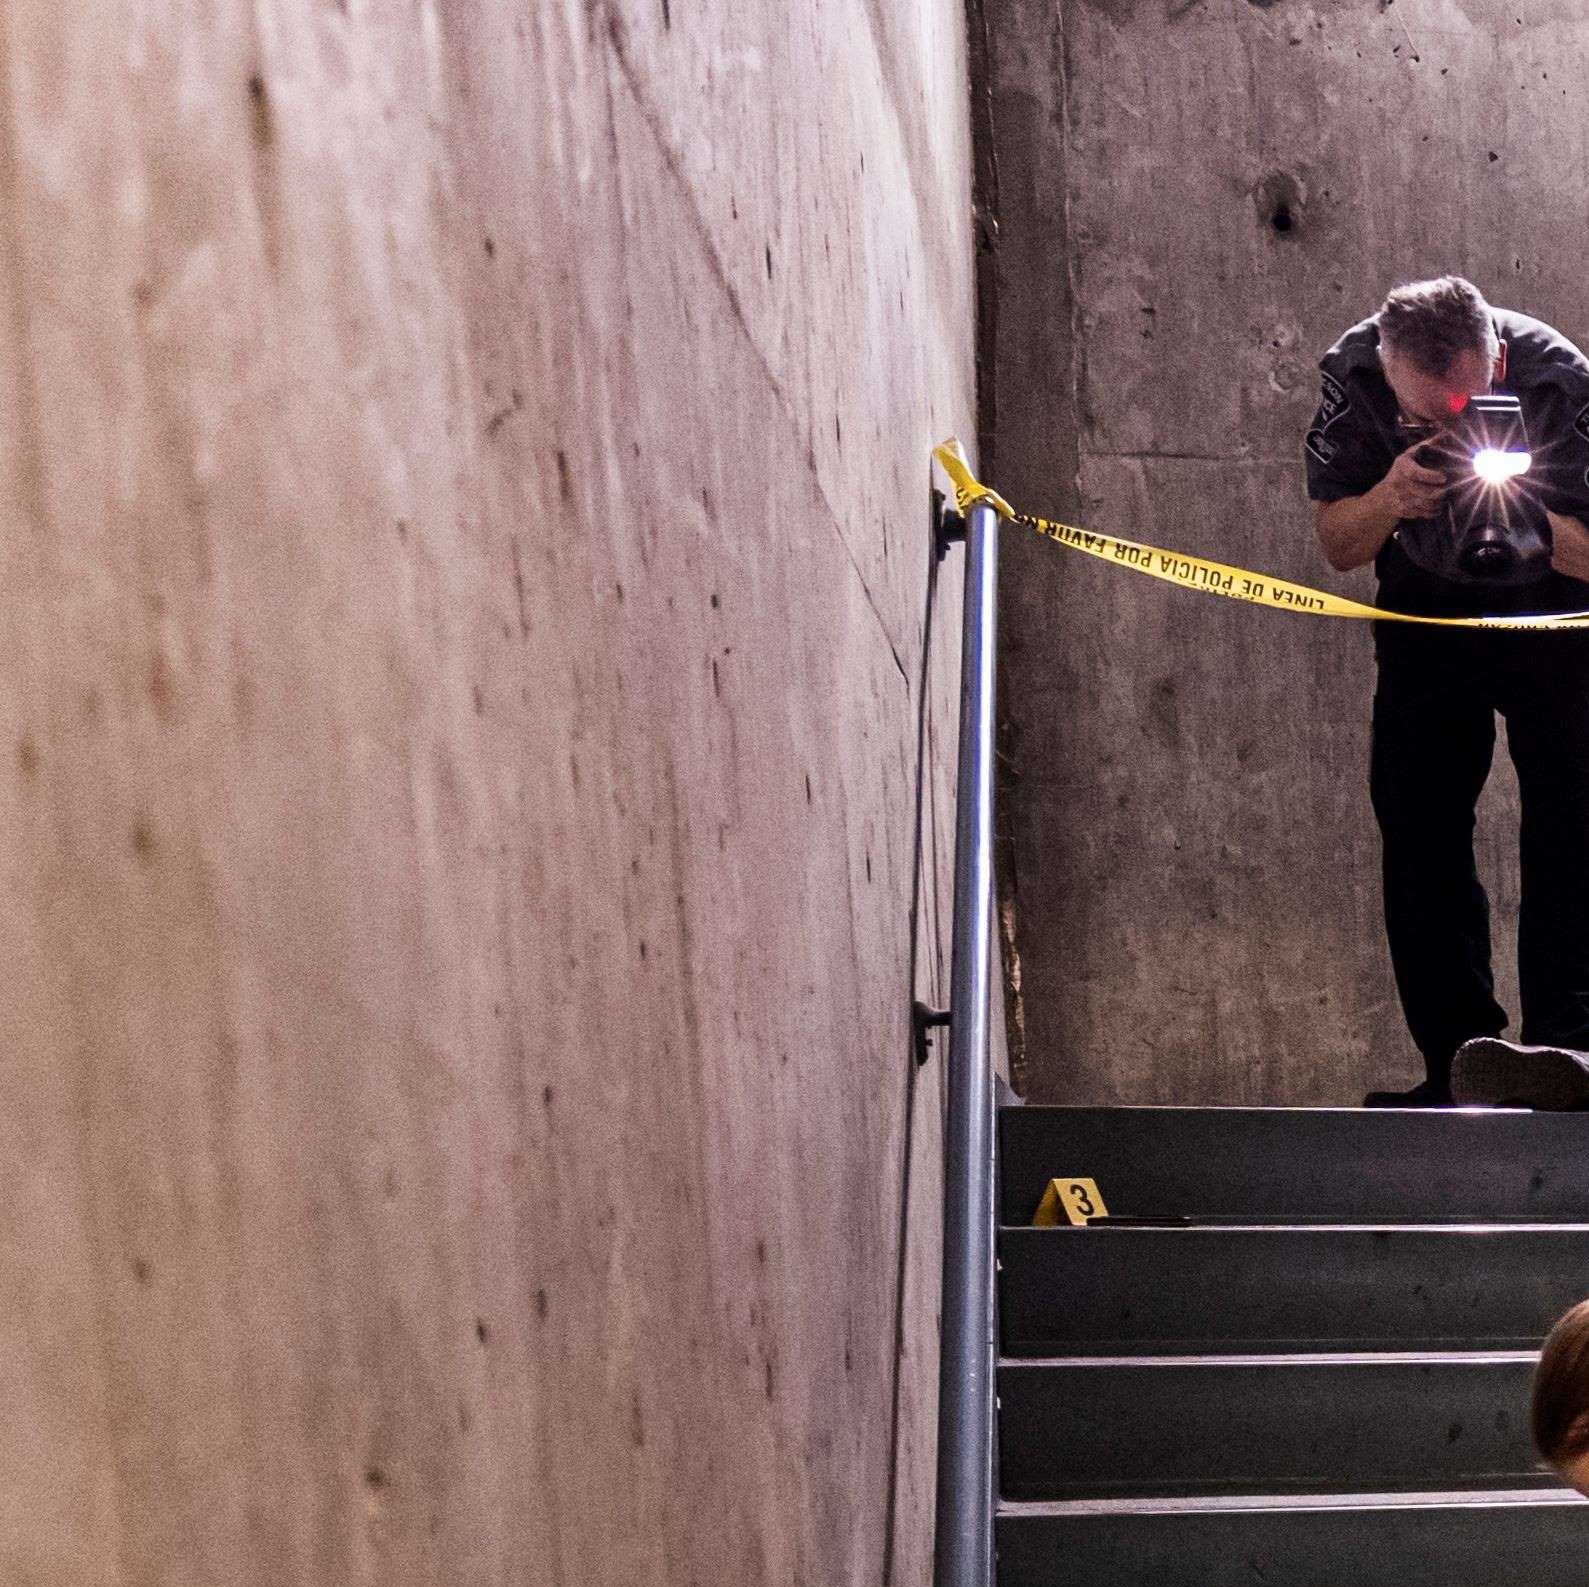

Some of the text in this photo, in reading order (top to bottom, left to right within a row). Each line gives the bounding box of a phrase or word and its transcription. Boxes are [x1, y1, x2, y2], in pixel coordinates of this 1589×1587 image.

[1114, 542, 1151, 568] POR
[1161, 555, 1233, 590] POLICIA
[1241, 580, 1264, 597] DE
[1272, 587, 1325, 610] LINEA
[1070, 1184, 1095, 1216] 3
